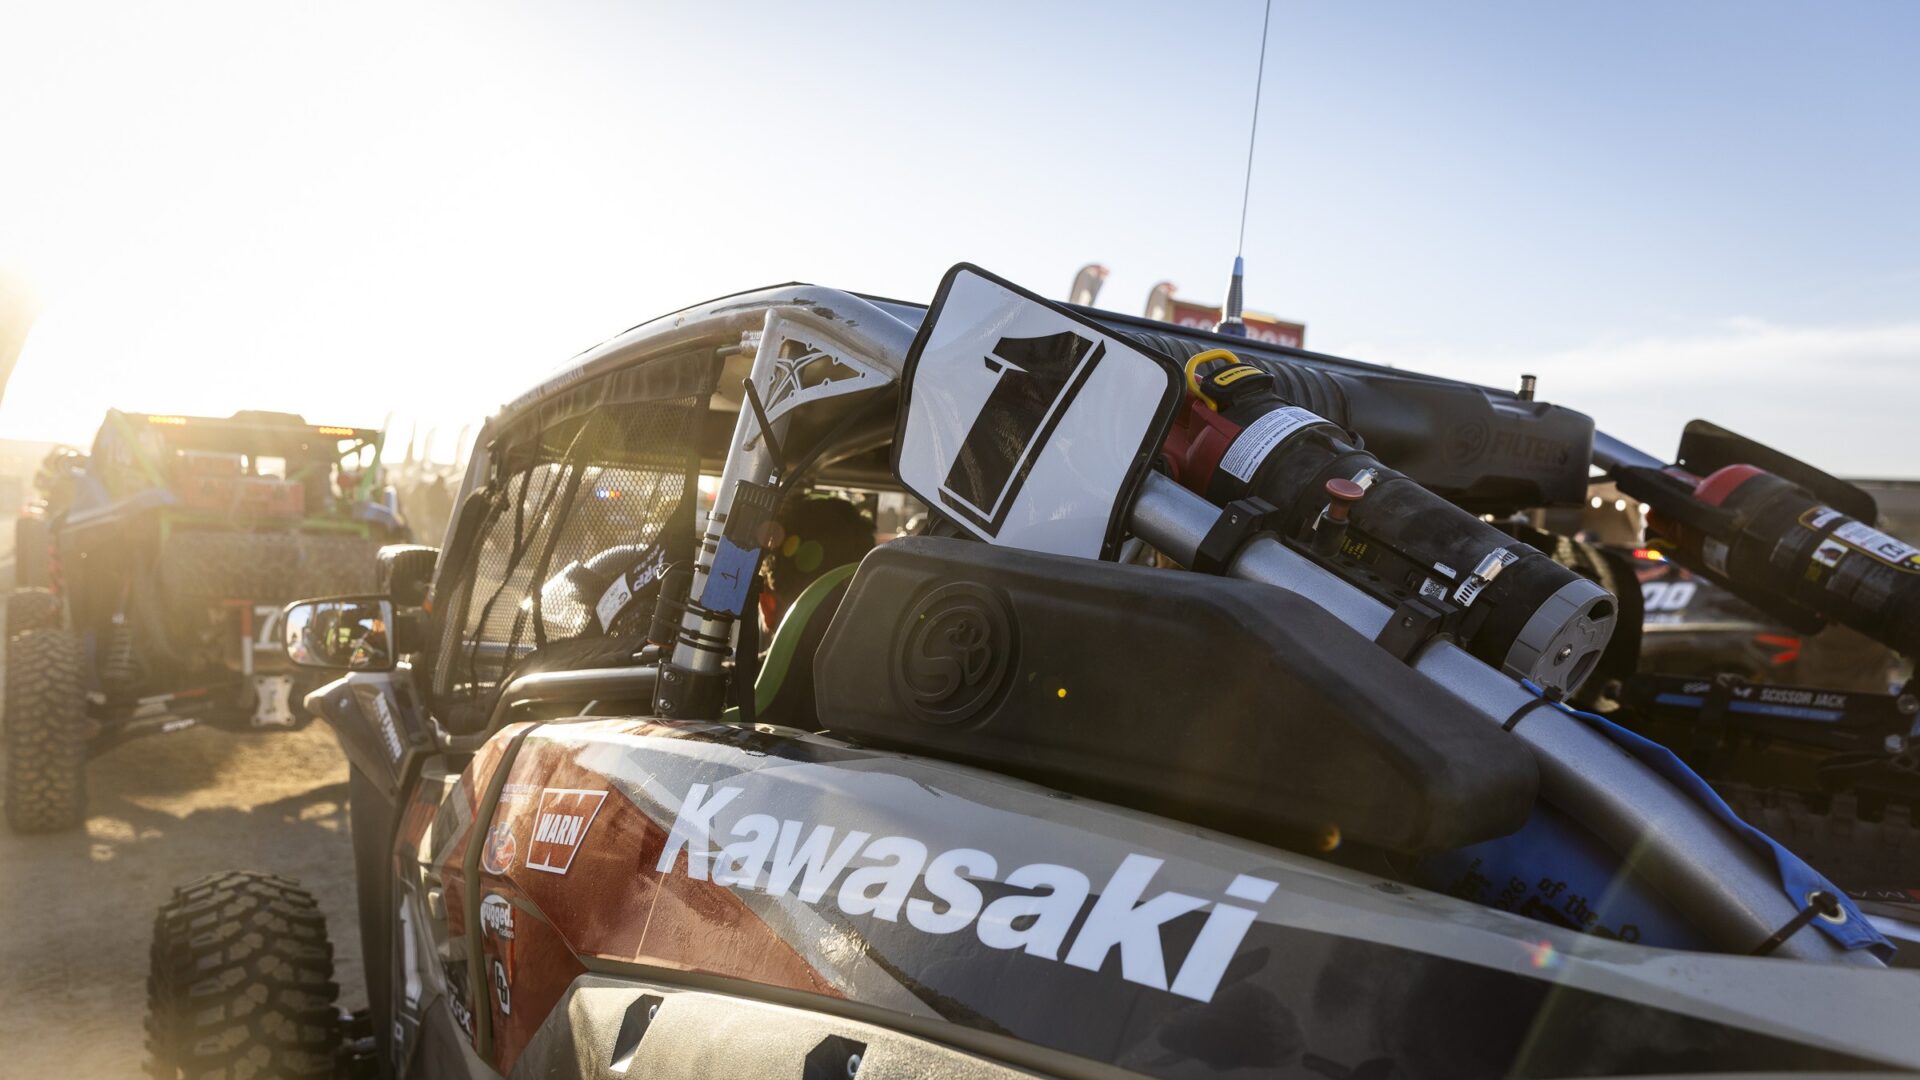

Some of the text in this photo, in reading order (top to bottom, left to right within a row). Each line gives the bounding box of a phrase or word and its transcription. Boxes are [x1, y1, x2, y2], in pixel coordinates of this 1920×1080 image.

[938, 331, 1106, 538] 1
[1760, 688, 1846, 708] SCISSOR JACK
[535, 813, 584, 846] WARN
[656, 783, 1280, 1003] Kawasaki
[1565, 894, 1600, 926] the
